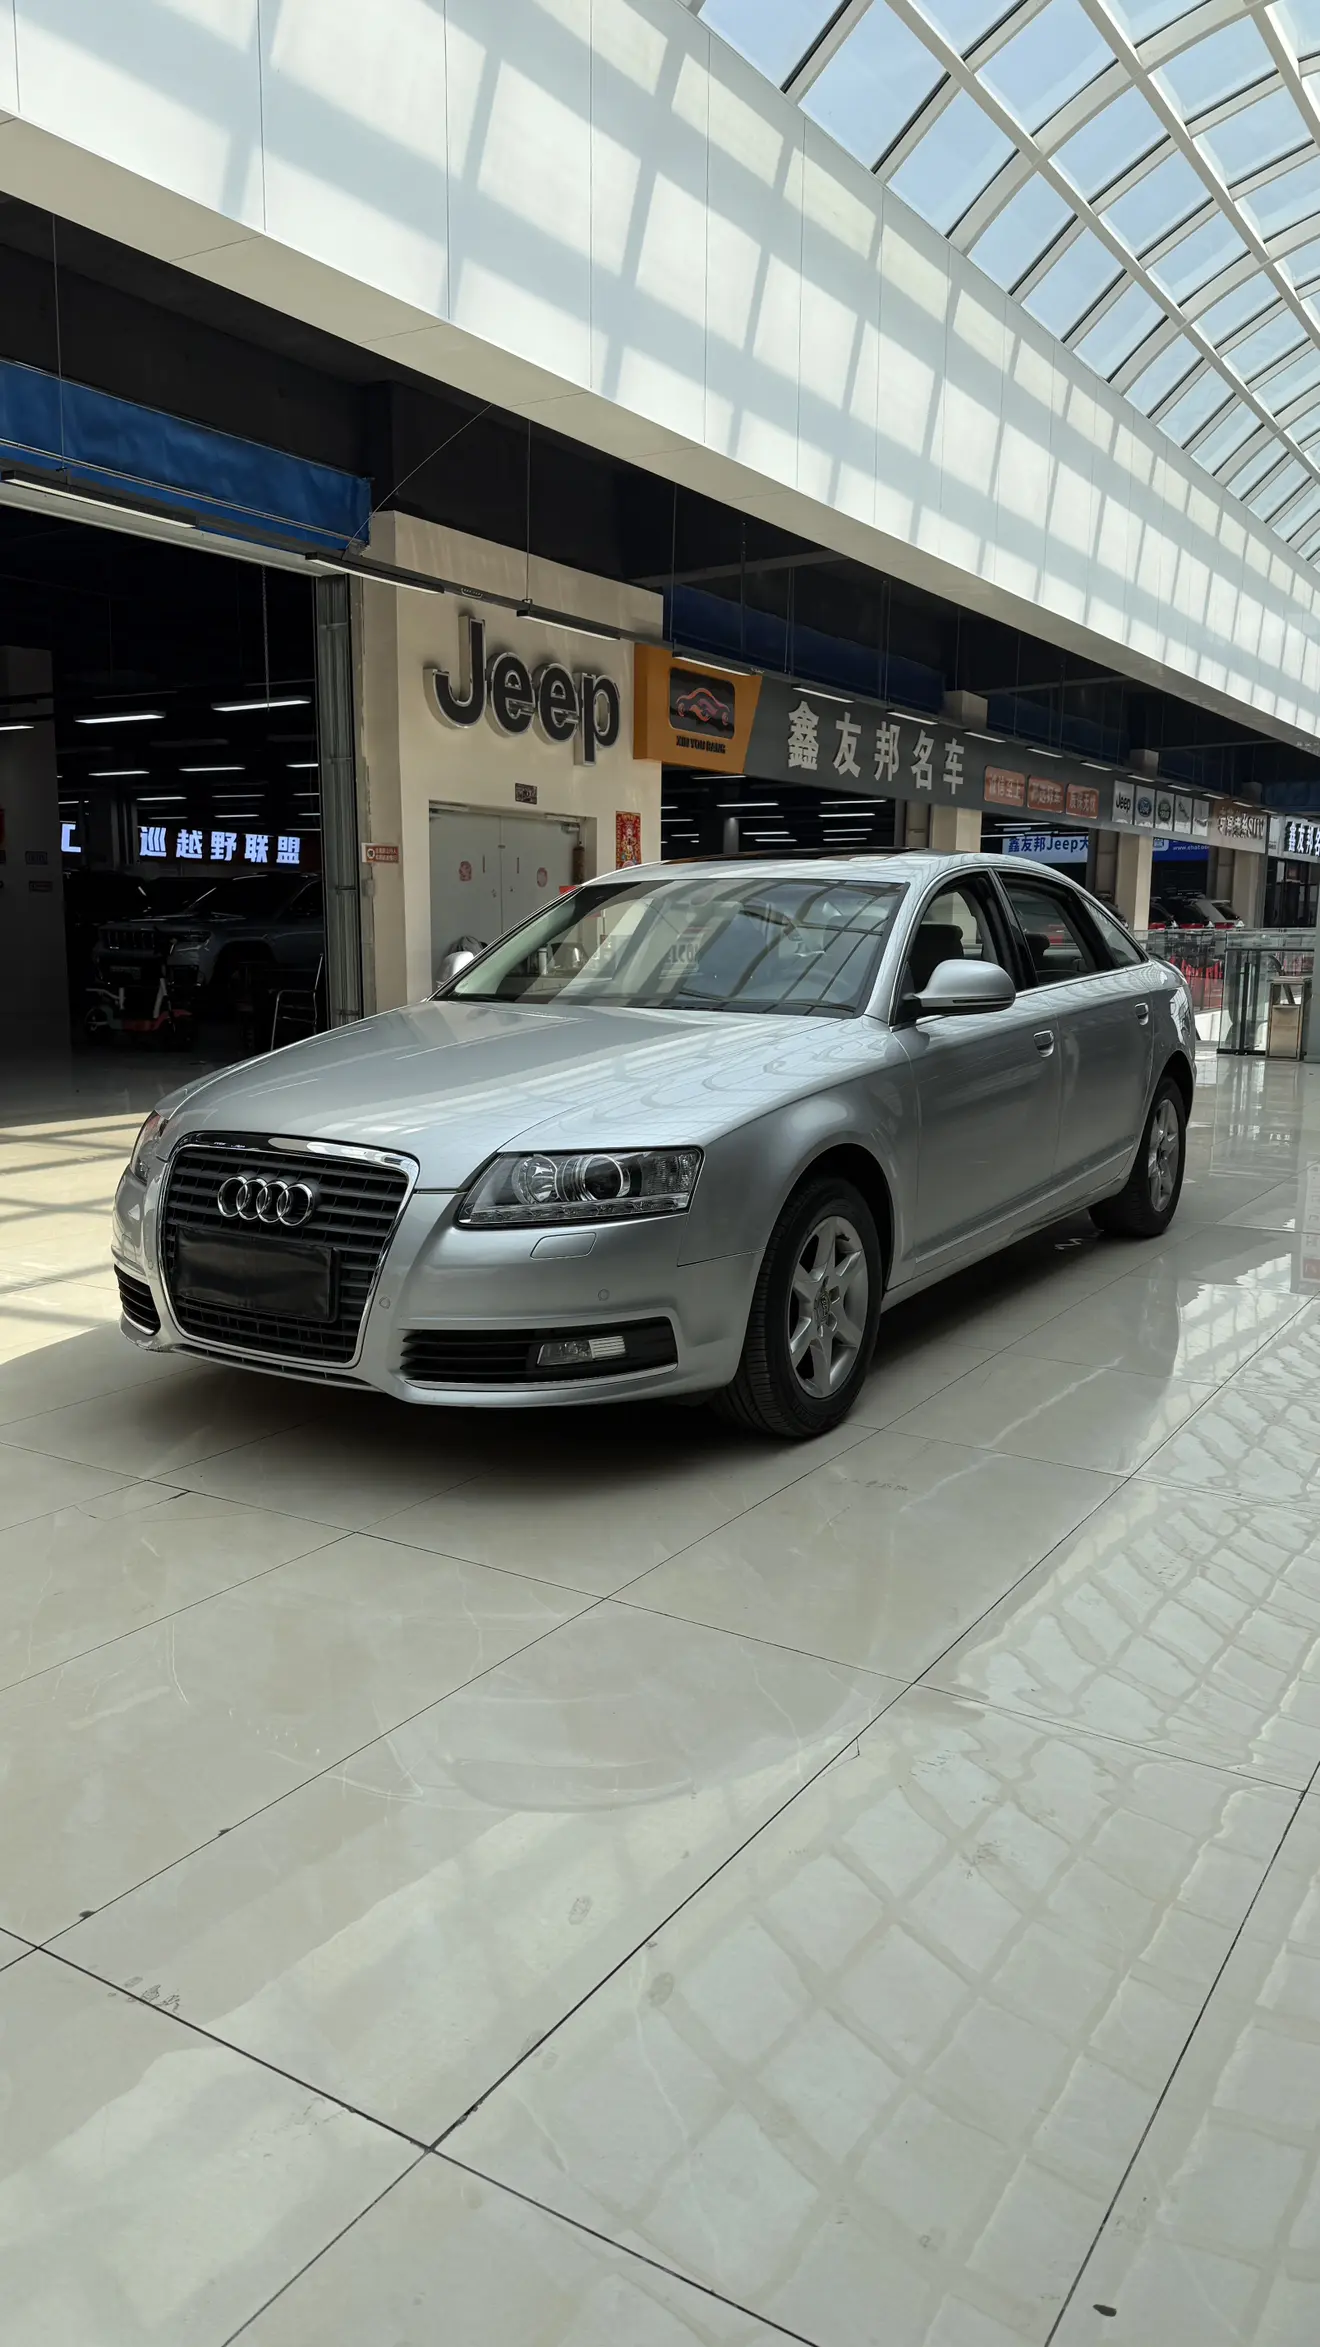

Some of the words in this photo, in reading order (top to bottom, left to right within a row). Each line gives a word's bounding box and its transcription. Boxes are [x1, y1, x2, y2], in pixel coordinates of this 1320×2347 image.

[423, 615, 620, 766] Jeep
[787, 700, 965, 794] 鑫友邦名车
[1116, 791, 1131, 813] Jeep
